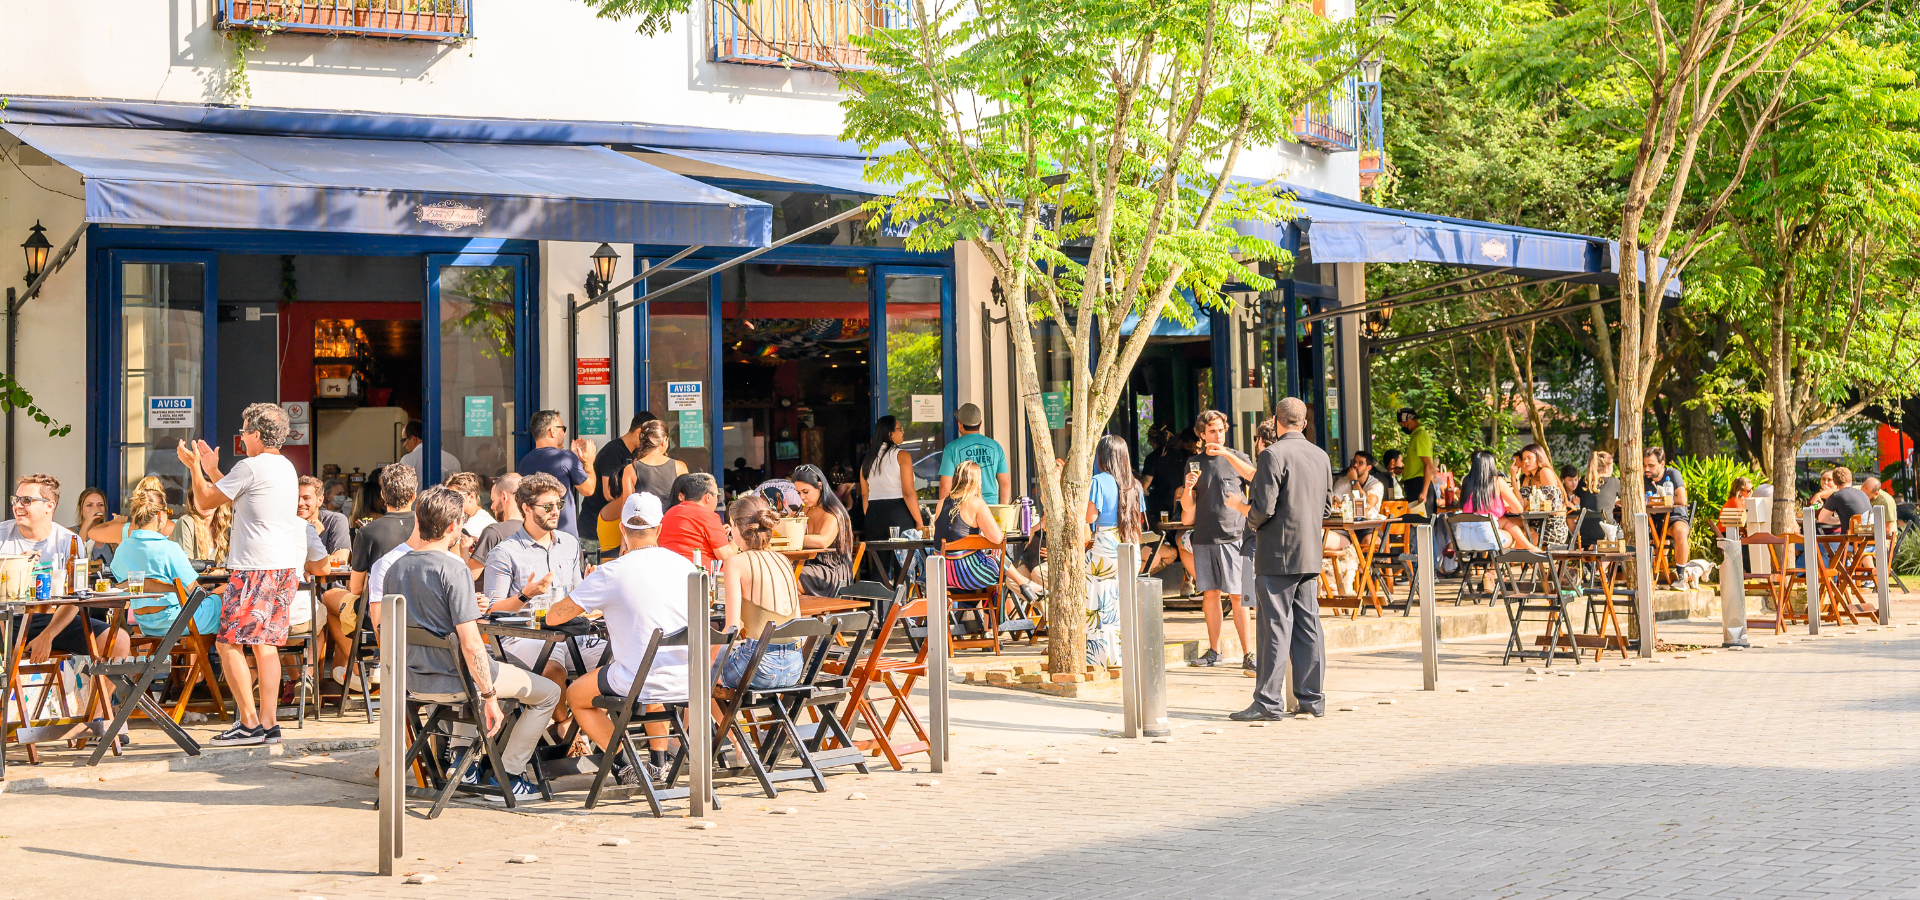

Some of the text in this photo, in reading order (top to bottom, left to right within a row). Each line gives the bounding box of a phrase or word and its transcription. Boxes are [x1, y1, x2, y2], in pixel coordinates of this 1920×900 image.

[674, 384, 697, 392] AVISO
[157, 399, 187, 408] AVISO
[966, 448, 988, 457] QUIK
